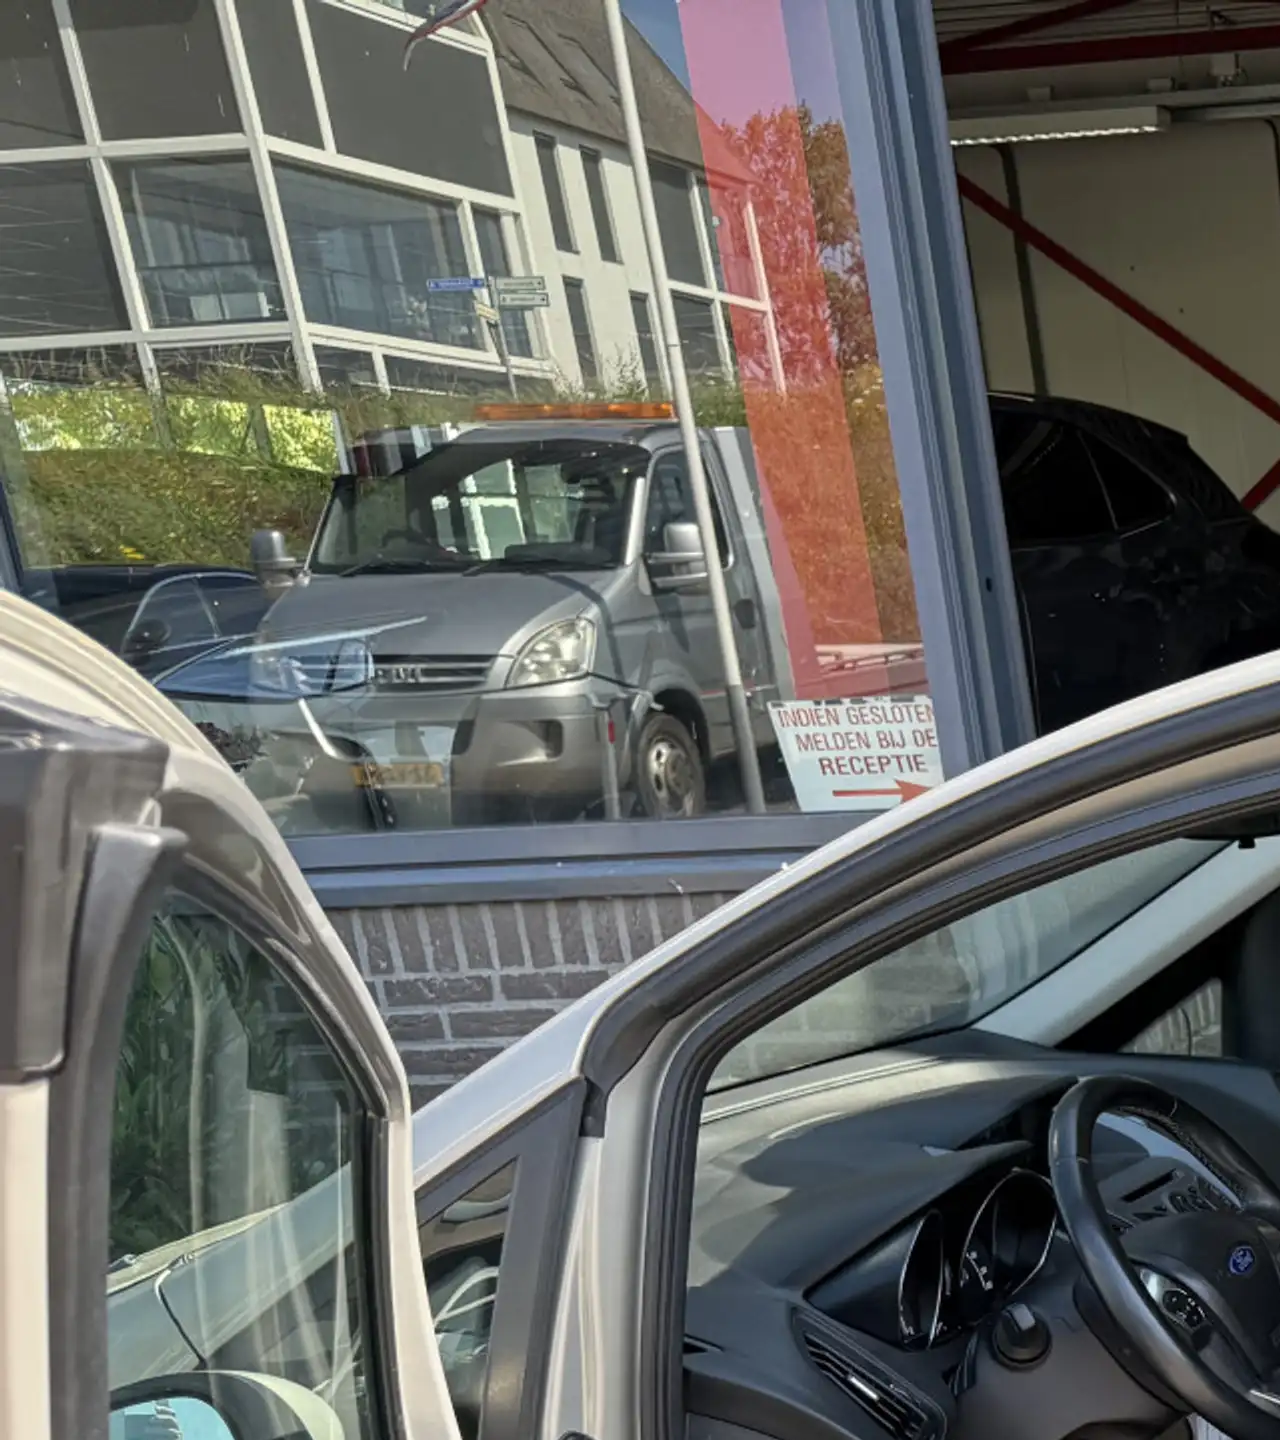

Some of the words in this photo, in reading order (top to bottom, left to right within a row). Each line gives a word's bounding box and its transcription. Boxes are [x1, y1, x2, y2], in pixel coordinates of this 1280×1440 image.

[778, 707, 841, 728] INDIEN
[795, 731, 871, 752] MELDEN
[876, 730, 906, 750] BIJ
[912, 728, 938, 748] DE
[818, 754, 929, 776] RECEPTIE
